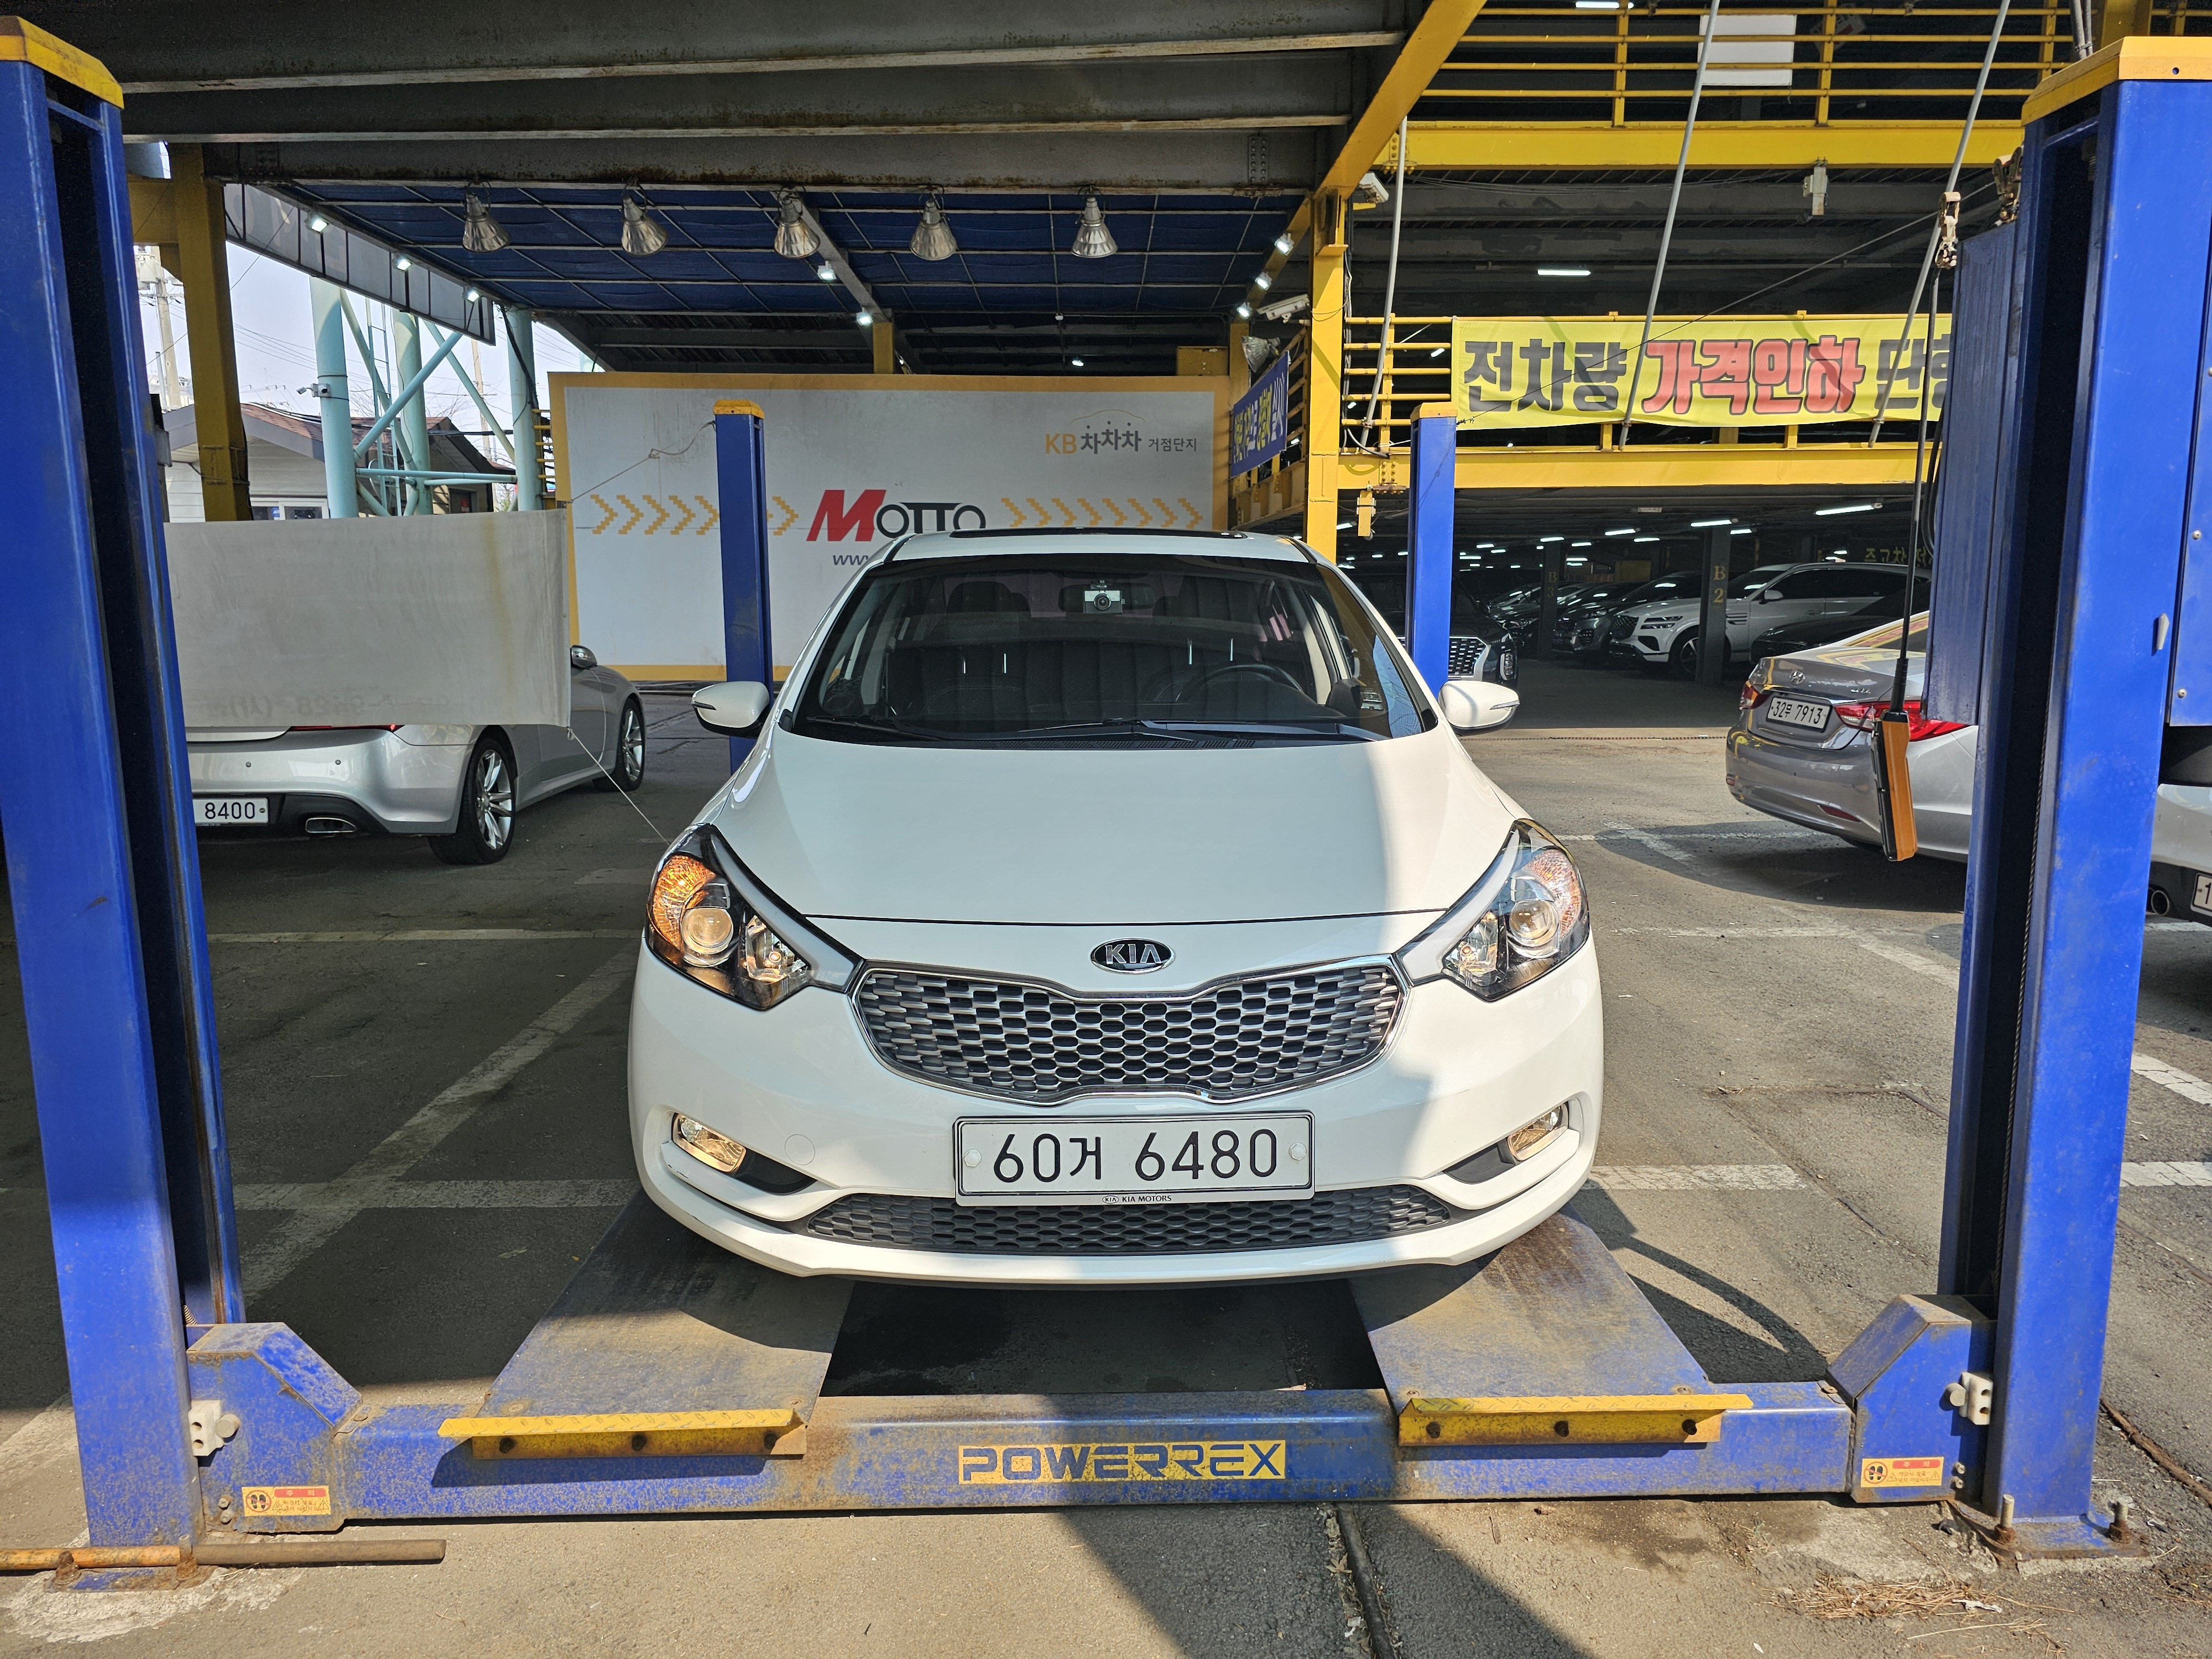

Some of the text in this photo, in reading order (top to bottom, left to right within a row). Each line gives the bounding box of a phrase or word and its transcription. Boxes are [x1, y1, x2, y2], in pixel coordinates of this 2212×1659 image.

[1464, 338, 1627, 413] 전차량
[1641, 335, 1866, 415] 가격인하
[1045, 426, 1196, 454] KB 차차차 거점단지
[806, 489, 986, 541] MOTTO
[1773, 701, 1823, 724] 32무 7913
[205, 802, 255, 820] 8400
[1105, 944, 1162, 964] KIA
[994, 1129, 1277, 1183] 60거 6480
[962, 1443, 1281, 1481] POWERREX
